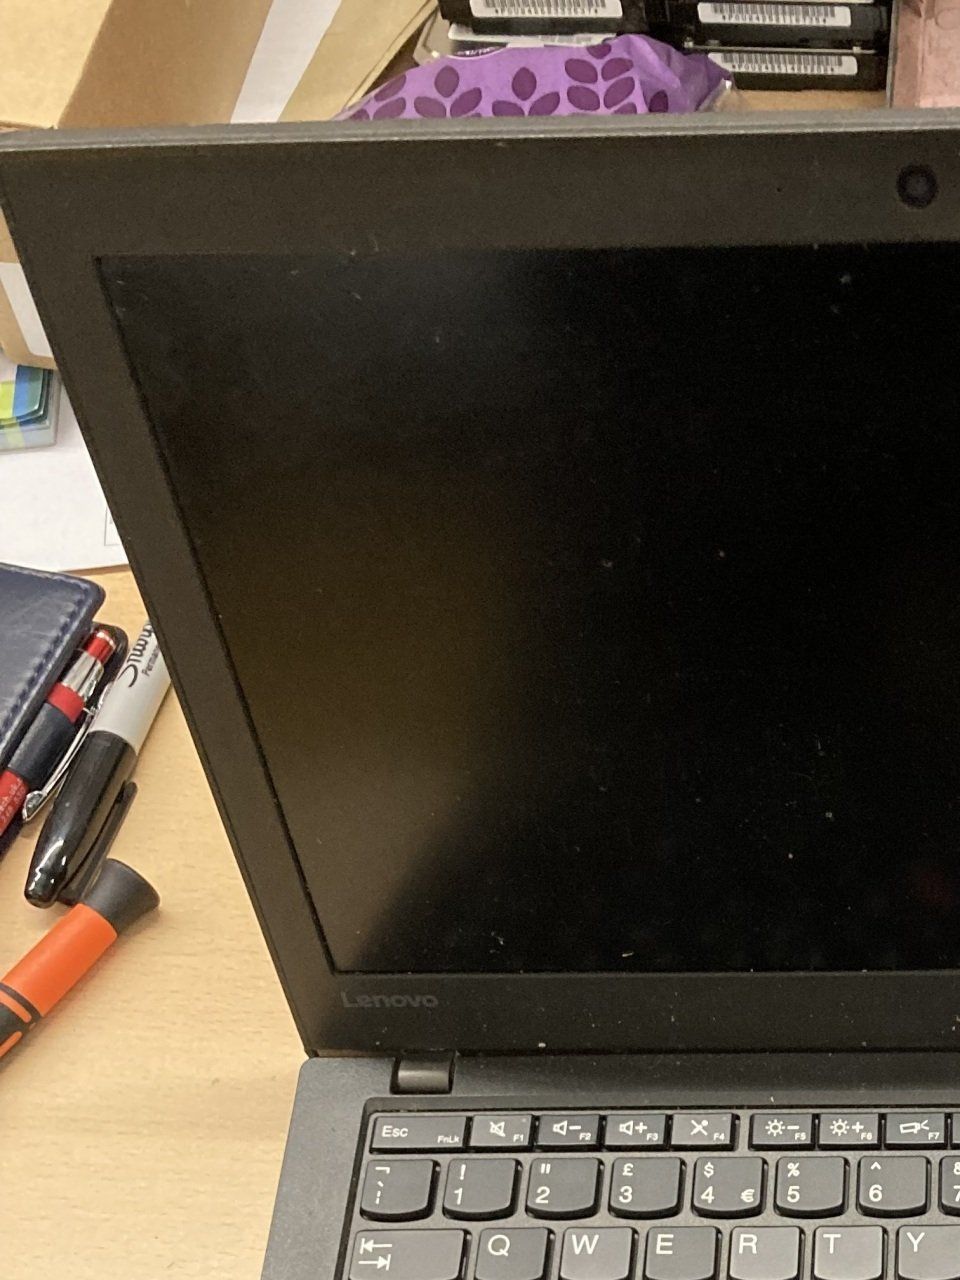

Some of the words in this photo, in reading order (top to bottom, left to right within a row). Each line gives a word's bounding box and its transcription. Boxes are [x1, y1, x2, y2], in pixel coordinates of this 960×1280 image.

[341, 991, 439, 1008] Lenovo
[381, 1125, 409, 1138] Esc
[437, 1135, 460, 1144] FnLk
[512, 1133, 524, 1143] F1
[579, 1132, 592, 1141] F2
[646, 1132, 659, 1141] F3
[713, 1132, 725, 1141] F4
[794, 1132, 807, 1141] F5
[860, 1132, 873, 1141] F6
[928, 1131, 940, 1141] F7
[459, 1163, 467, 1181] !
[622, 1162, 634, 1177] £
[703, 1161, 714, 1179] $
[787, 1162, 801, 1178] %
[454, 1187, 463, 1205] 1
[535, 1186, 551, 1204] 2
[618, 1185, 633, 1204] 3
[700, 1185, 715, 1204] 4
[740, 1188, 755, 1203] €
[786, 1185, 800, 1203] 5
[868, 1184, 883, 1202] 6
[487, 1234, 511, 1257] Q
[571, 1234, 600, 1255] W
[655, 1233, 674, 1255] E
[738, 1233, 758, 1254] R
[822, 1233, 842, 1254] T
[906, 1231, 926, 1253] Y
